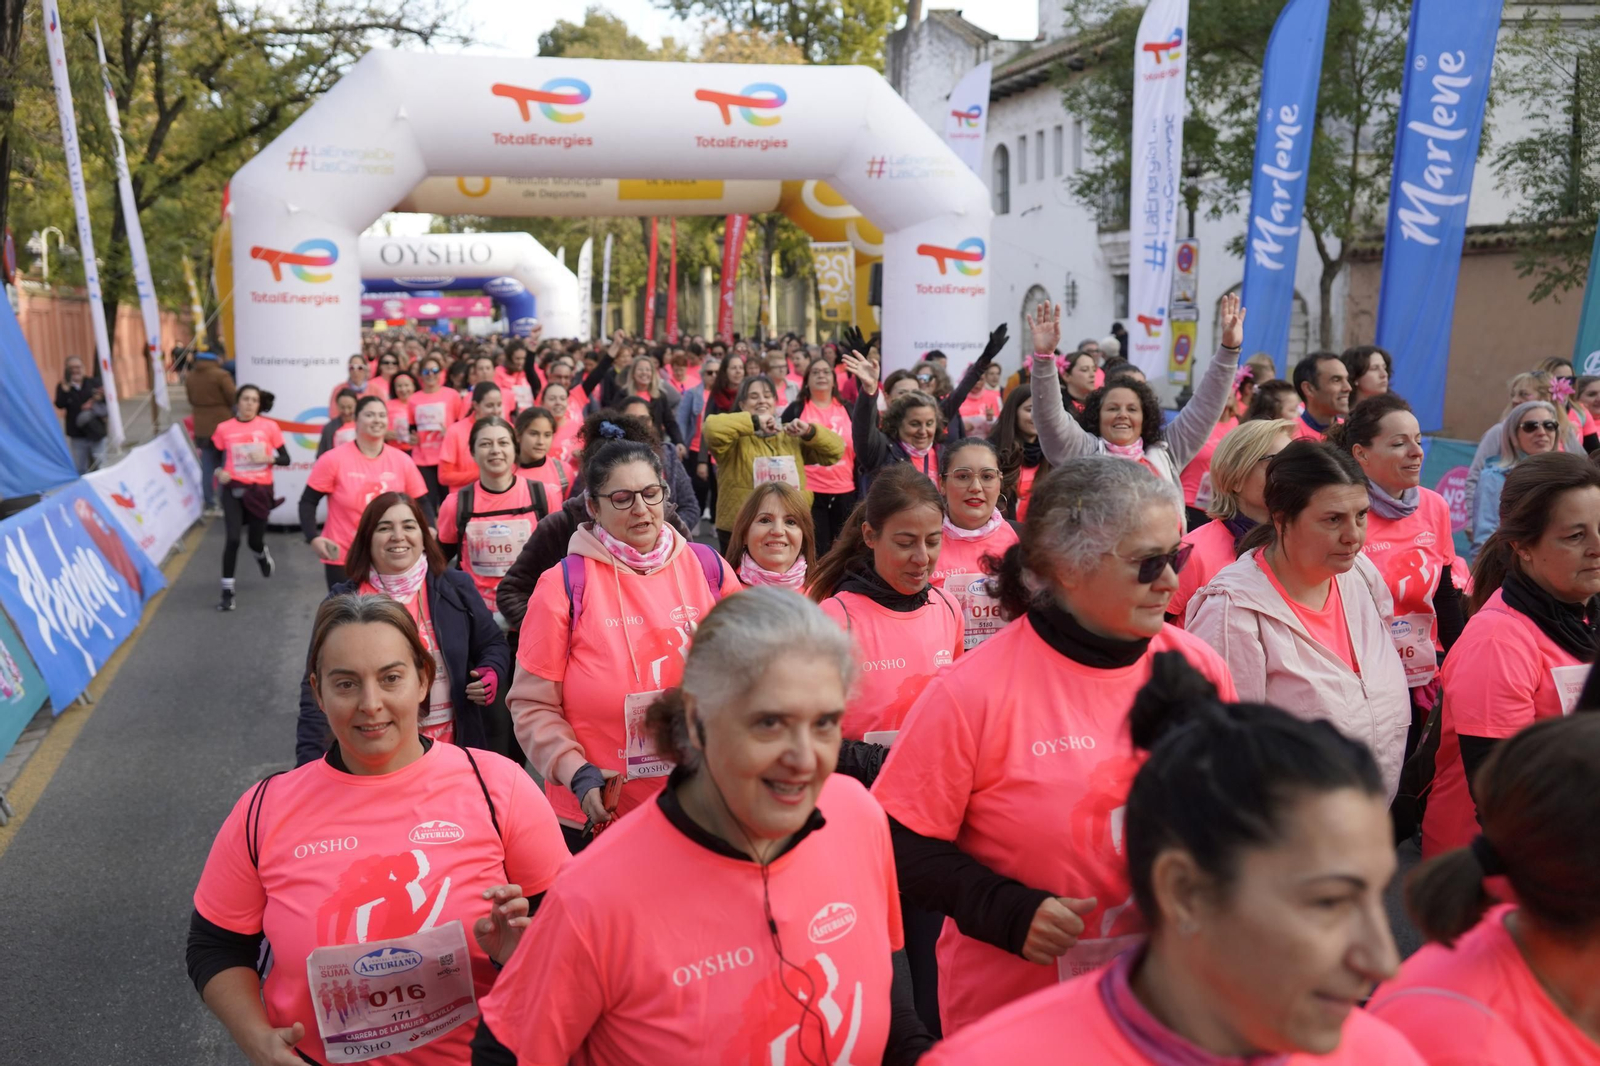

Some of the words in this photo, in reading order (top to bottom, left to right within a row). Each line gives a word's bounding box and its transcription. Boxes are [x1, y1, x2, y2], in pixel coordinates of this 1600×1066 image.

[492, 133, 593, 149] TotalEnergies
[695, 136, 788, 150] TotalEnergies
[1398, 50, 1472, 245] Marlene
[522, 188, 537, 199] de
[538, 189, 587, 200] Deportes
[1253, 104, 1302, 270] Marlene
[380, 242, 492, 266] OYSHO
[250, 291, 340, 306] TotalEnergies
[251, 355, 340, 368] totalenergies.es
[769, 473, 787, 481] 016
[488, 544, 513, 554] 016
[931, 567, 967, 579] OYSHO
[972, 605, 1001, 618] 016
[1397, 646, 1415, 659] 16
[862, 657, 906, 672] OYSHO
[1567, 686, 1582, 694] SUM
[633, 708, 646, 716] SUM
[1031, 735, 1096, 757] OYSHO
[638, 763, 670, 775] OYSHO
[413, 830, 460, 840] ASTURIANA
[294, 836, 358, 859] OYSHO
[360, 957, 418, 973] ASTURIANA
[672, 946, 754, 987] OYSHO
[320, 969, 350, 979] SUMA
[369, 984, 426, 1008] 016
[345, 1030, 379, 1041] CARRERA
[379, 1027, 389, 1036] DE
[390, 1024, 400, 1033] LA
[401, 1019, 425, 1030] MUJER
[429, 1004, 456, 1021] SEVILLA
[391, 1009, 412, 1022] 171
[419, 1013, 462, 1038] Santander
[343, 1040, 391, 1056] OYSHO
